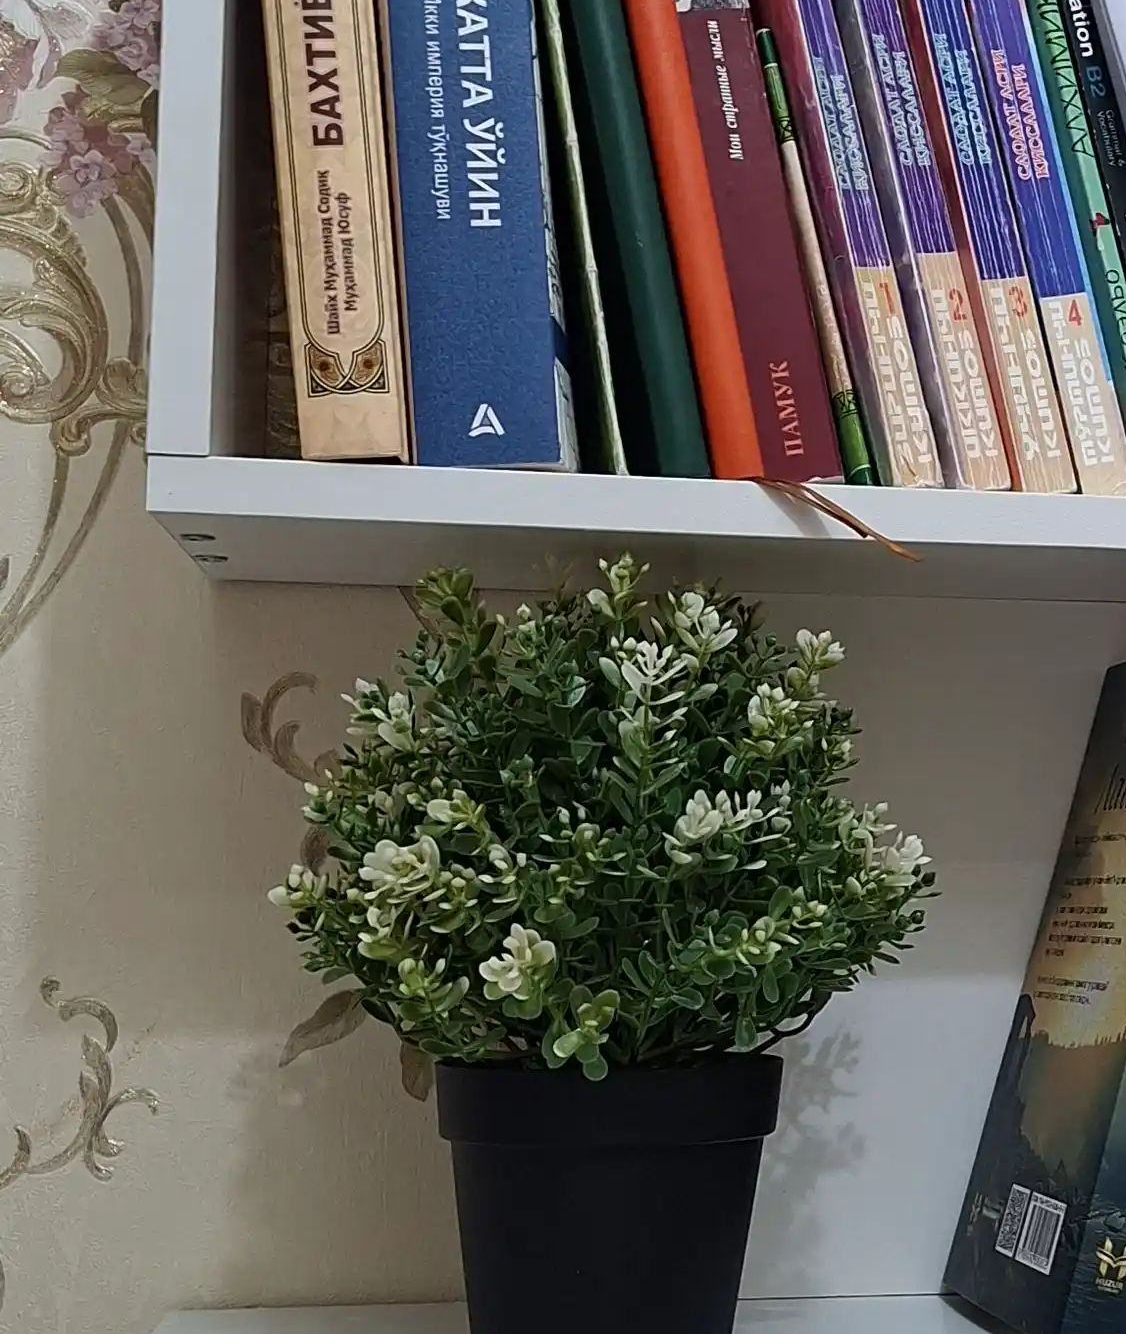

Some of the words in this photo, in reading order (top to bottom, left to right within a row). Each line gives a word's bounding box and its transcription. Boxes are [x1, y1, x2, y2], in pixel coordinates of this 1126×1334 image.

[707, 20, 725, 61] мысли
[872, 33, 897, 89] АСРИ
[934, 33, 956, 85] АСРИ
[425, 41, 444, 118] империя
[716, 65, 739, 129] странные
[991, 49, 1014, 101] АСРИ
[1085, 65, 1106, 98] B2
[727, 132, 745, 161] Мои
[885, 89, 913, 166] САОДАТ
[947, 86, 974, 166] САОДАТ
[1003, 103, 1031, 180] САОДАТ
[1096, 111, 1116, 167] Vocabulary
[1106, 109, 1123, 156] Grammar
[427, 124, 451, 219] тўқнашуви
[463, 117, 505, 227] ЎЙИН
[335, 192, 352, 230] Юсуф
[321, 217, 339, 293] Муҳаммад
[341, 237, 358, 312] Муҳаммад
[324, 294, 340, 335] Шайх
[878, 282, 895, 316] 1
[949, 288, 967, 321] 2
[1008, 286, 1029, 317] 3
[1068, 298, 1082, 327] 4
[769, 361, 803, 457] ПАМУК
